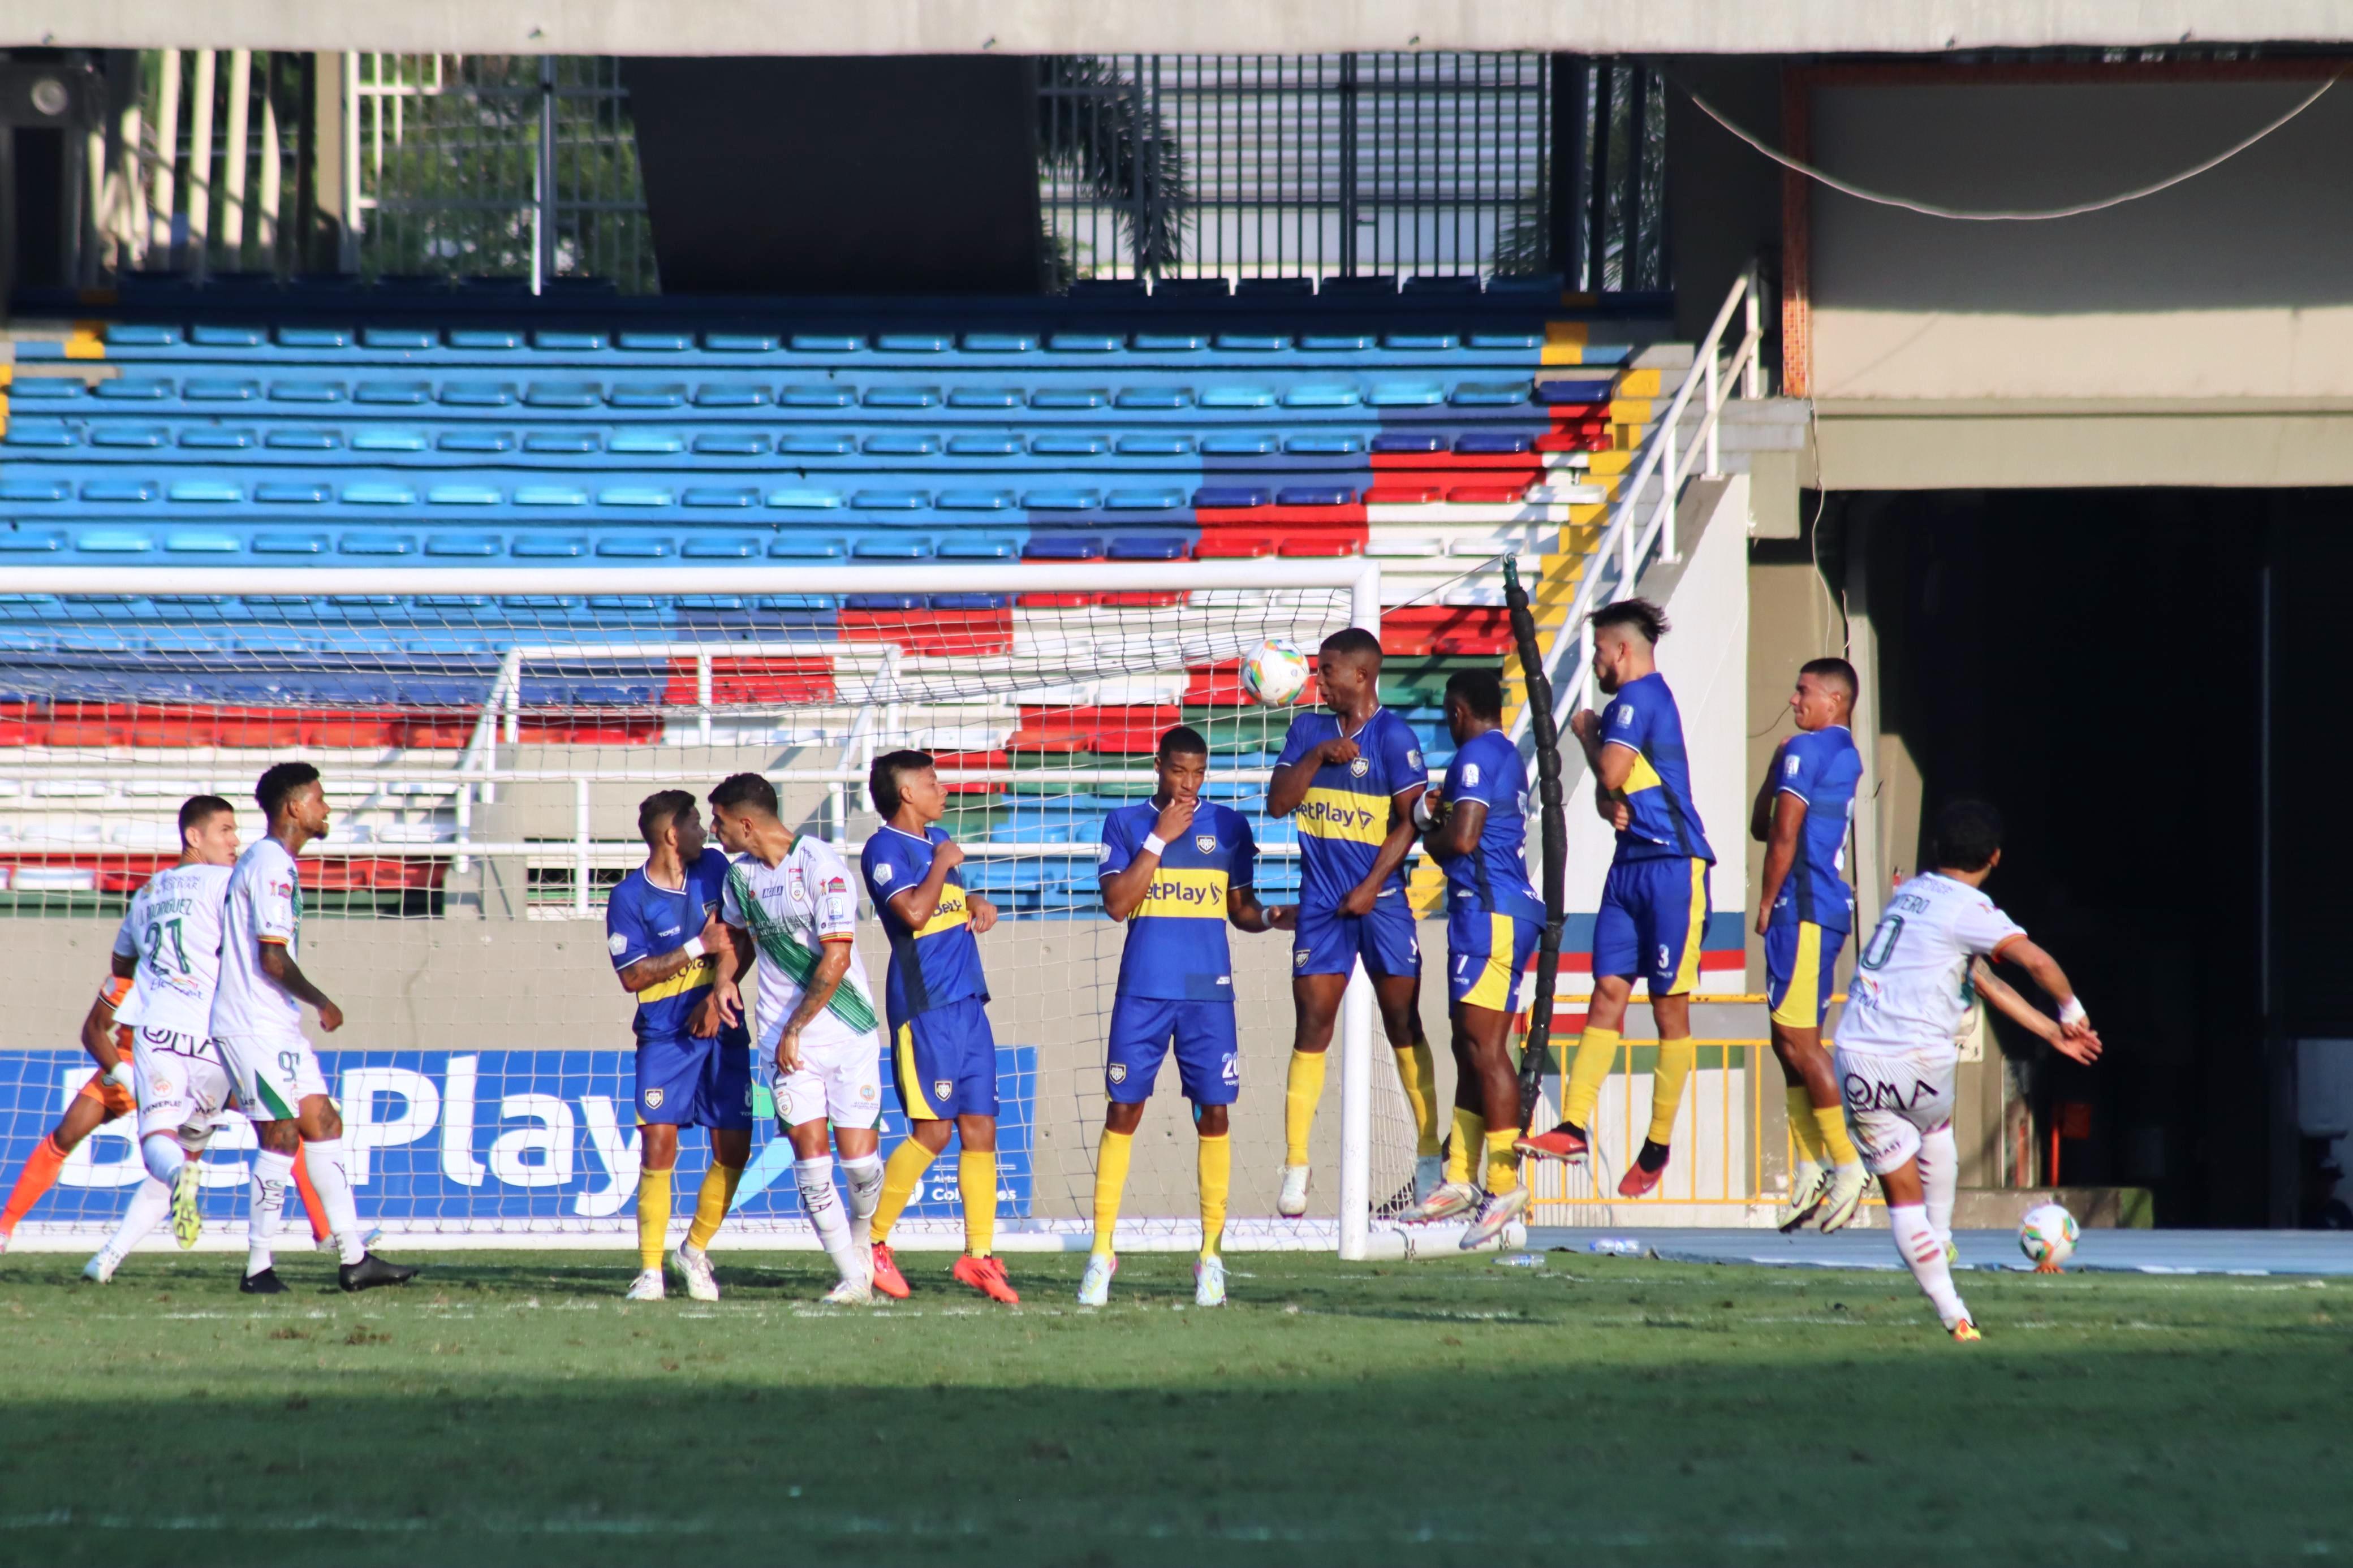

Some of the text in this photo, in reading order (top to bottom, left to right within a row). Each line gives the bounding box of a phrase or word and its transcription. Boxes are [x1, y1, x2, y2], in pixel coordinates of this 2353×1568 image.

[1145, 882, 1206, 905] etPlay
[145, 918, 191, 977] 21
[1658, 944, 1669, 969] 3
